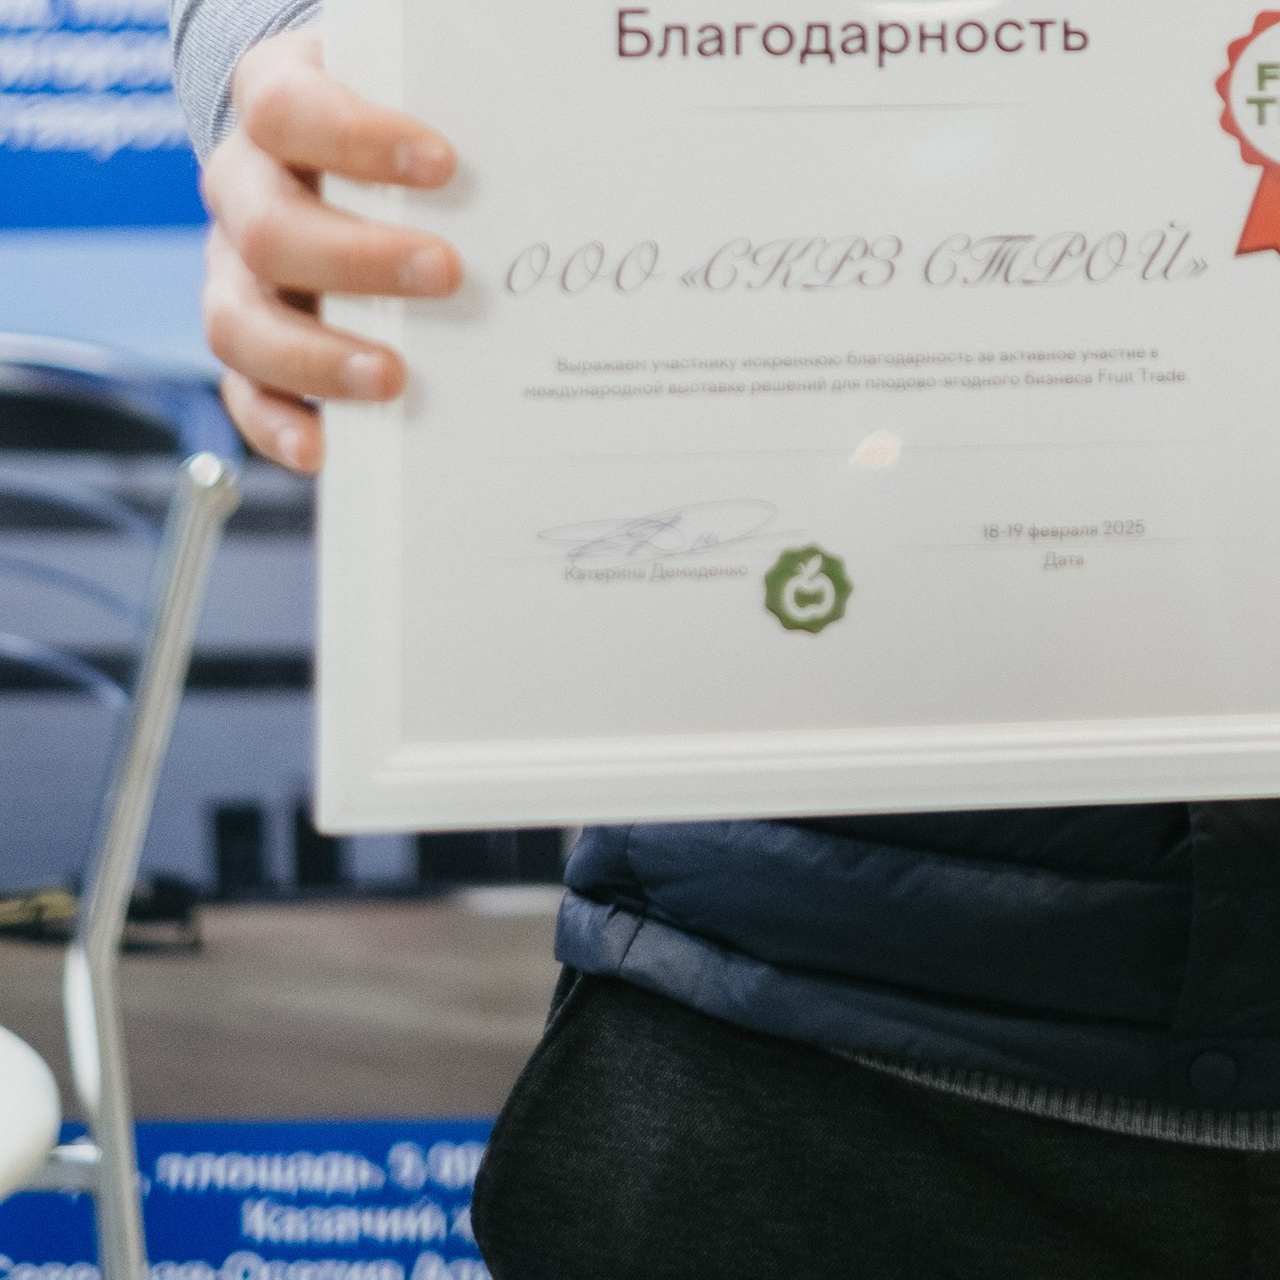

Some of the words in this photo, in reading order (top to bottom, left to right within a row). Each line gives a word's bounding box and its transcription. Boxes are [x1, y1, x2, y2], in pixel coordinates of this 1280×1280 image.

[616, 6, 1091, 69] Благодарность
[506, 238, 664, 293] ООО
[556, 355, 647, 376] Выражаем
[652, 356, 738, 375] участнику
[742, 353, 842, 372] искреннюю
[846, 349, 973, 369] благодарность
[977, 351, 995, 363] за
[999, 348, 1076, 362] активное
[1081, 346, 1146, 364] участие
[1150, 346, 1159, 359] в
[524, 380, 661, 400] международной
[668, 380, 744, 396] выставке
[750, 376, 827, 396] решений
[831, 377, 861, 394] для
[865, 374, 1020, 392] плодово-ягодного
[1024, 370, 1093, 387] бизнеса
[1097, 367, 1134, 384] Fruit
[982, 522, 1024, 539] 18-19
[1028, 522, 1100, 541] февраля
[1103, 519, 1146, 536] 2025
[564, 564, 647, 582] Катерина
[650, 562, 749, 582] Демиденко
[1043, 551, 1085, 570] Дата
[241, 1193, 448, 1243] Казачий
